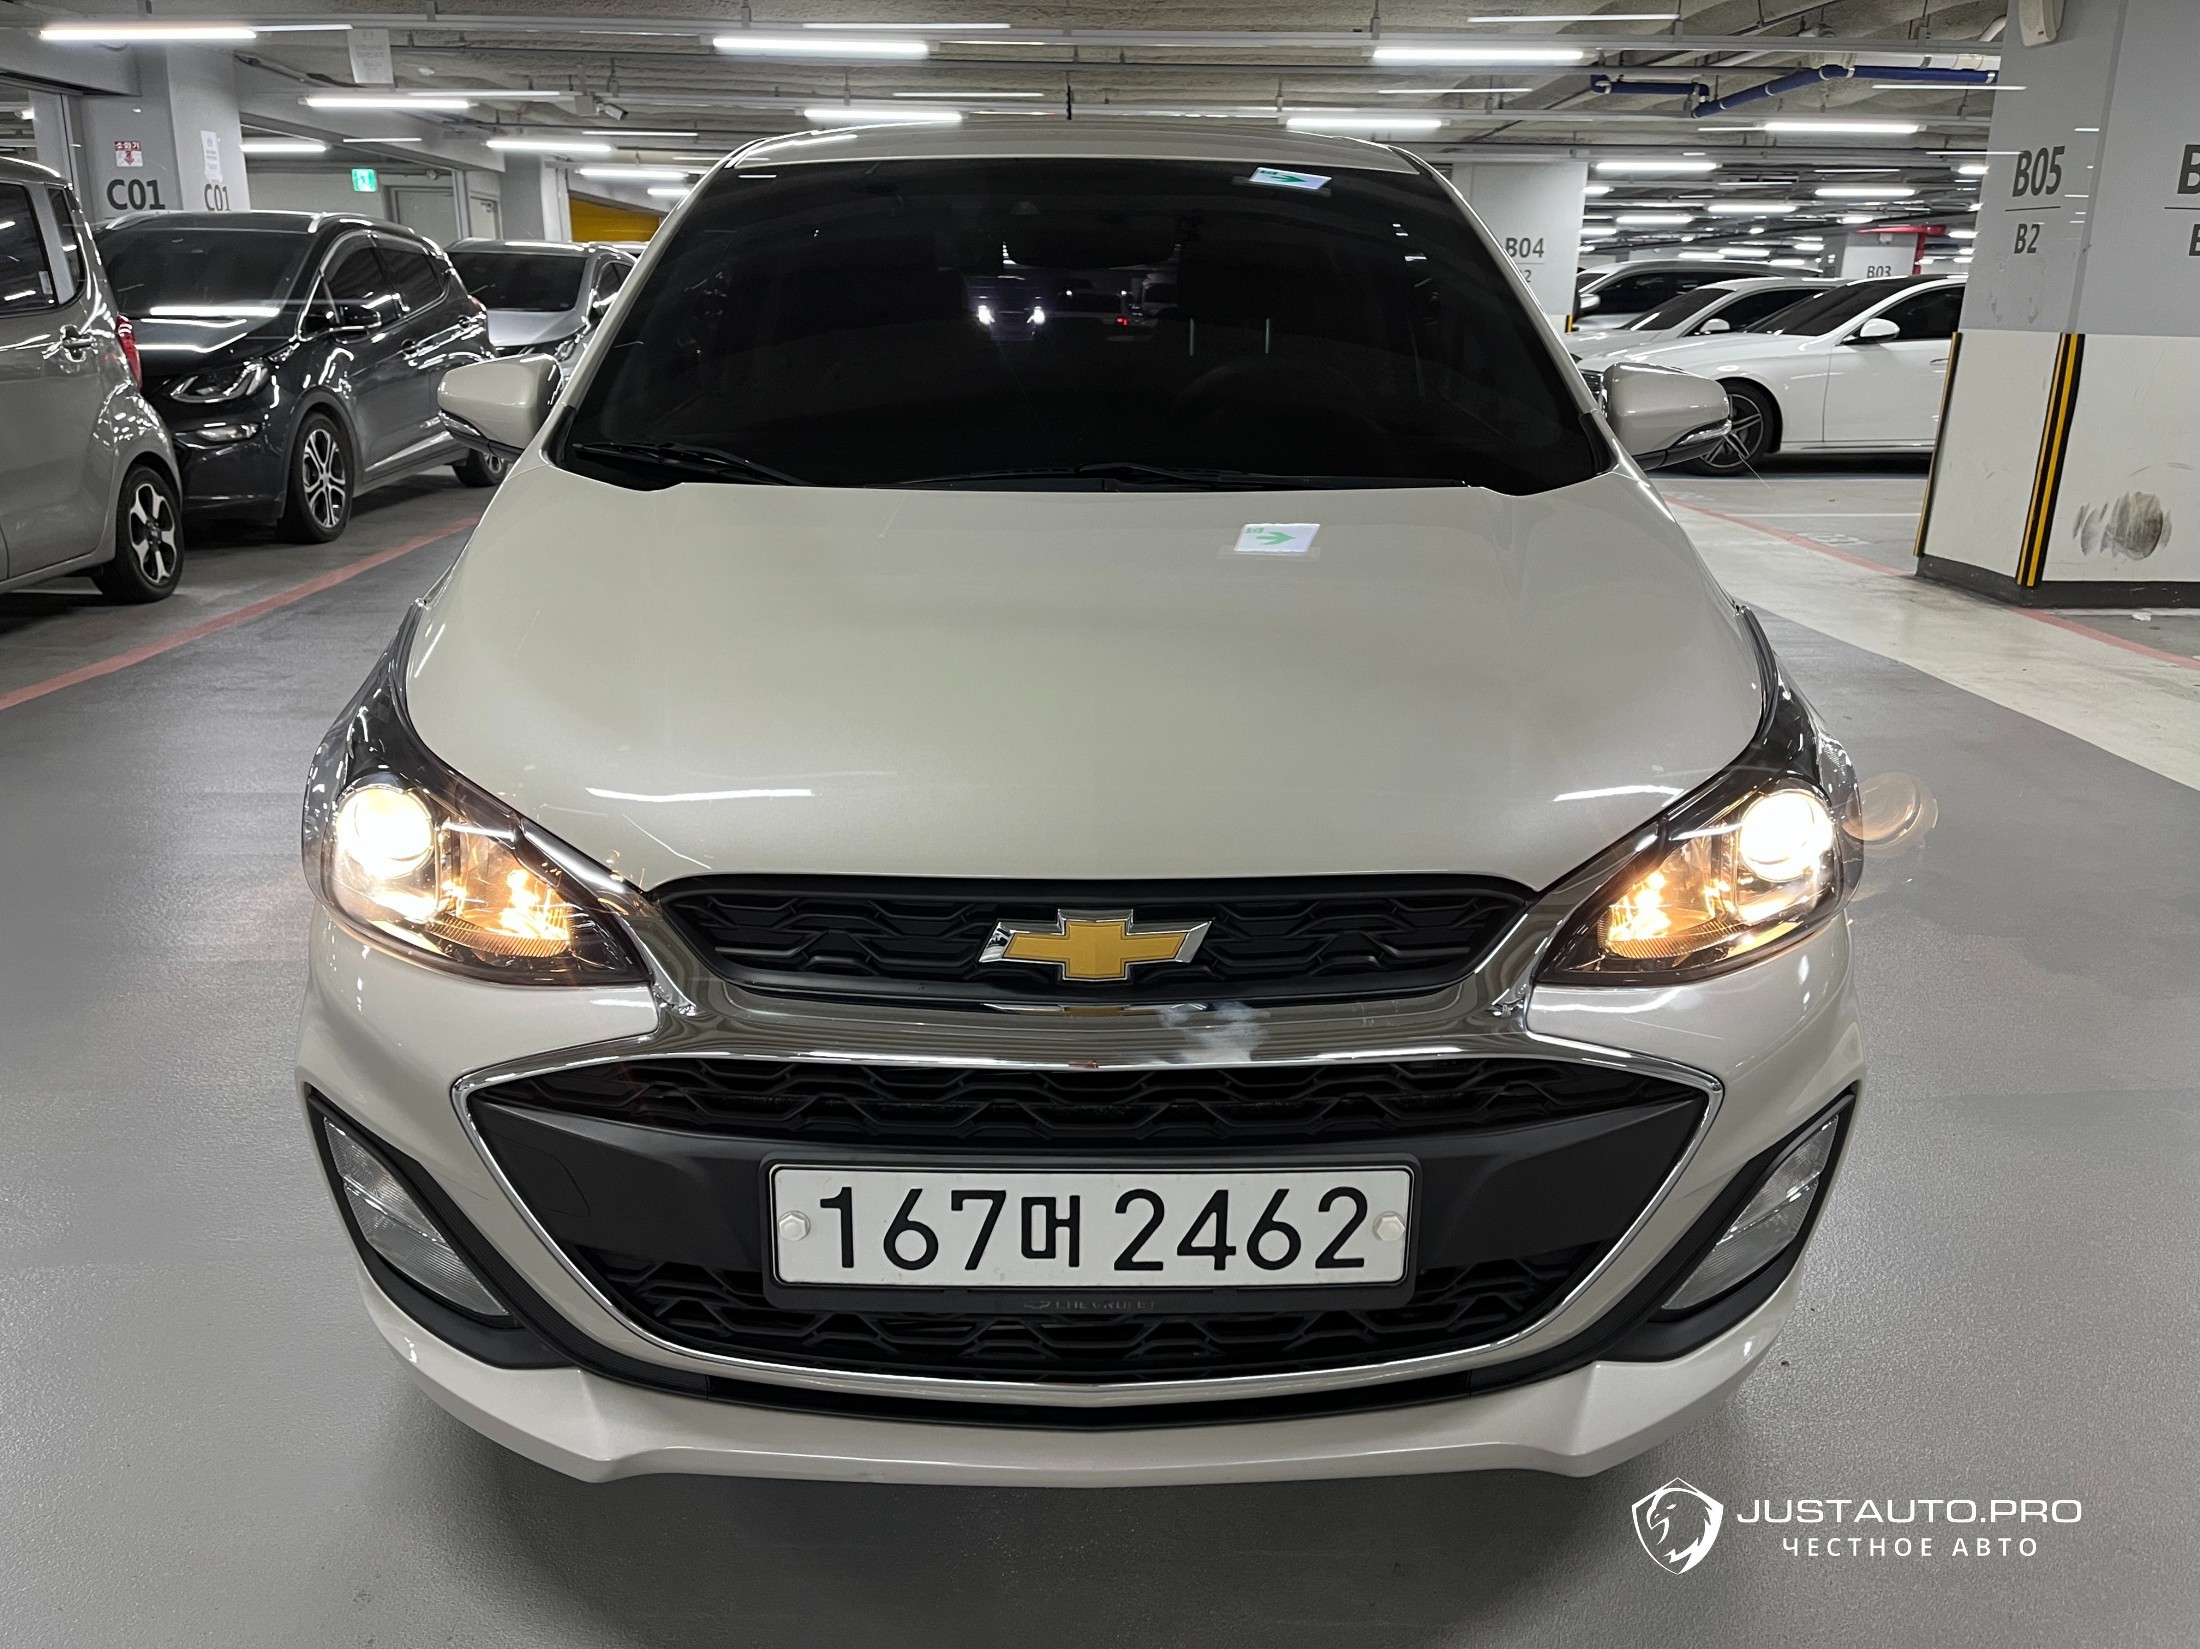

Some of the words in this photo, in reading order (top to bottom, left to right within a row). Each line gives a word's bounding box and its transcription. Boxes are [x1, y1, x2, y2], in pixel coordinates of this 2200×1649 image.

[2012, 146, 2065, 197] B05
[106, 179, 165, 211] C01
[204, 183, 231, 211] C01
[1505, 237, 1544, 258] B04
[2014, 223, 2040, 254] B2
[1867, 265, 1891, 279] B03
[819, 1186, 1081, 1271] 167머
[1113, 1186, 1369, 1272] 2462
